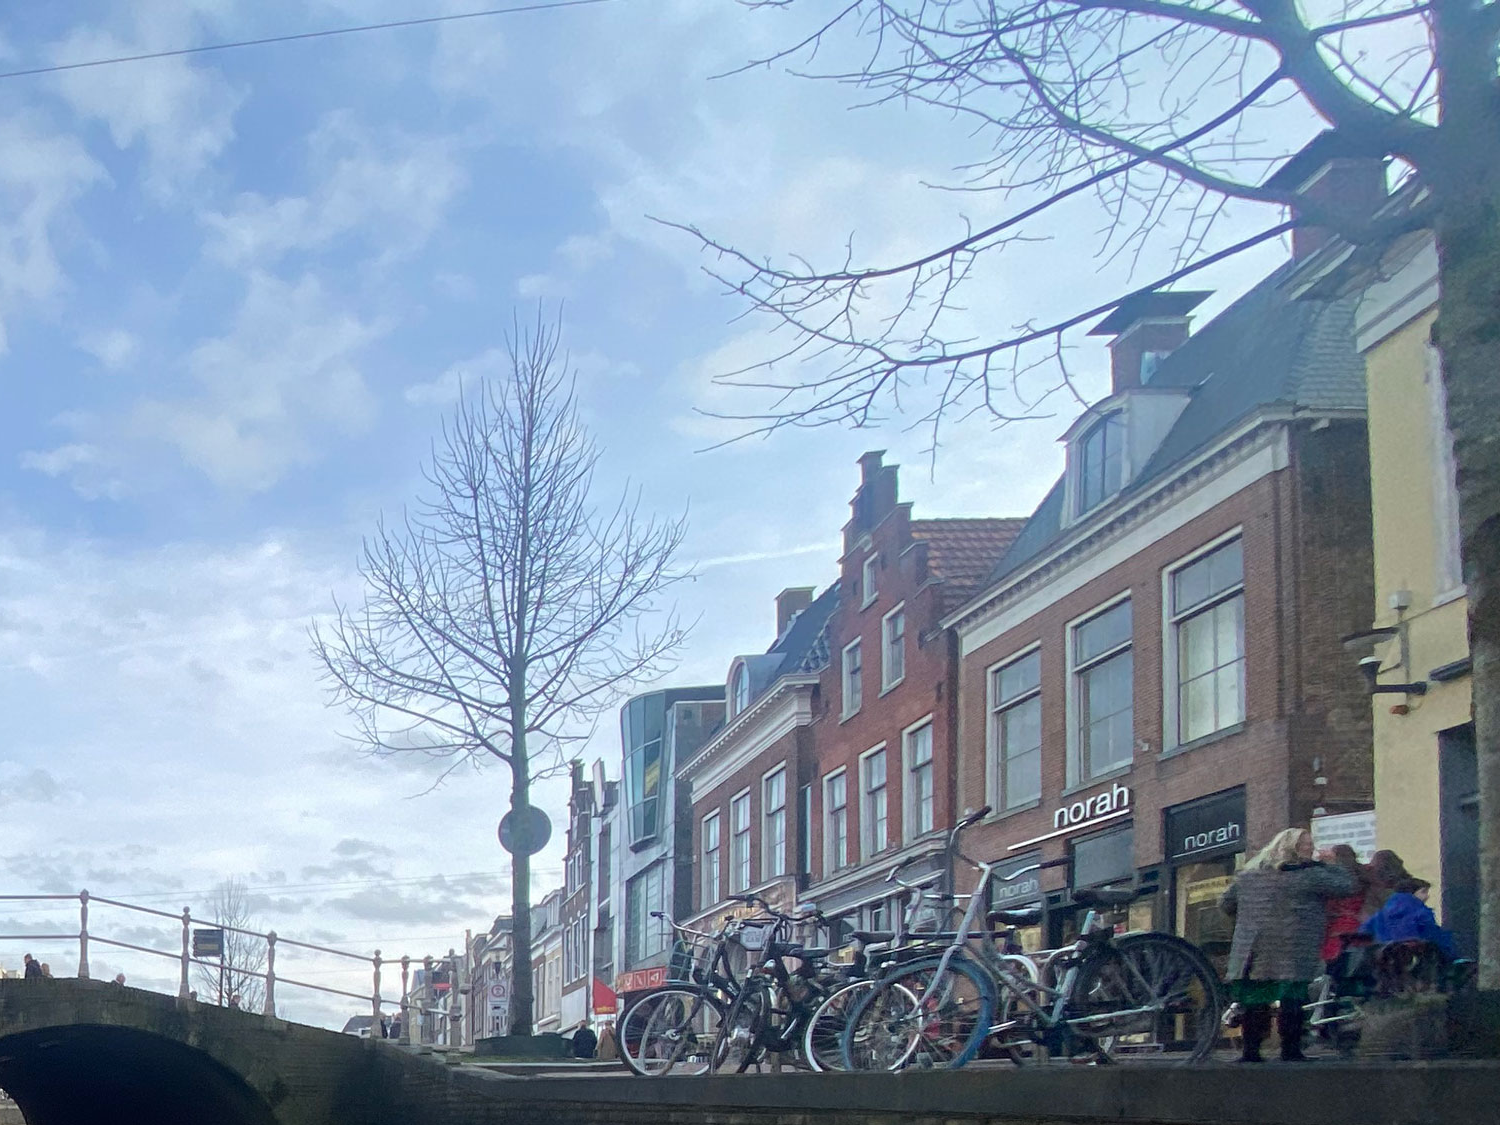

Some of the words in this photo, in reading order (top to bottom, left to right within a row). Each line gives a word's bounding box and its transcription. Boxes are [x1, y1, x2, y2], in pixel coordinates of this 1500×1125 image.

[1054, 783, 1130, 828] norah
[1184, 821, 1240, 850] norah
[999, 877, 1039, 897] norah
